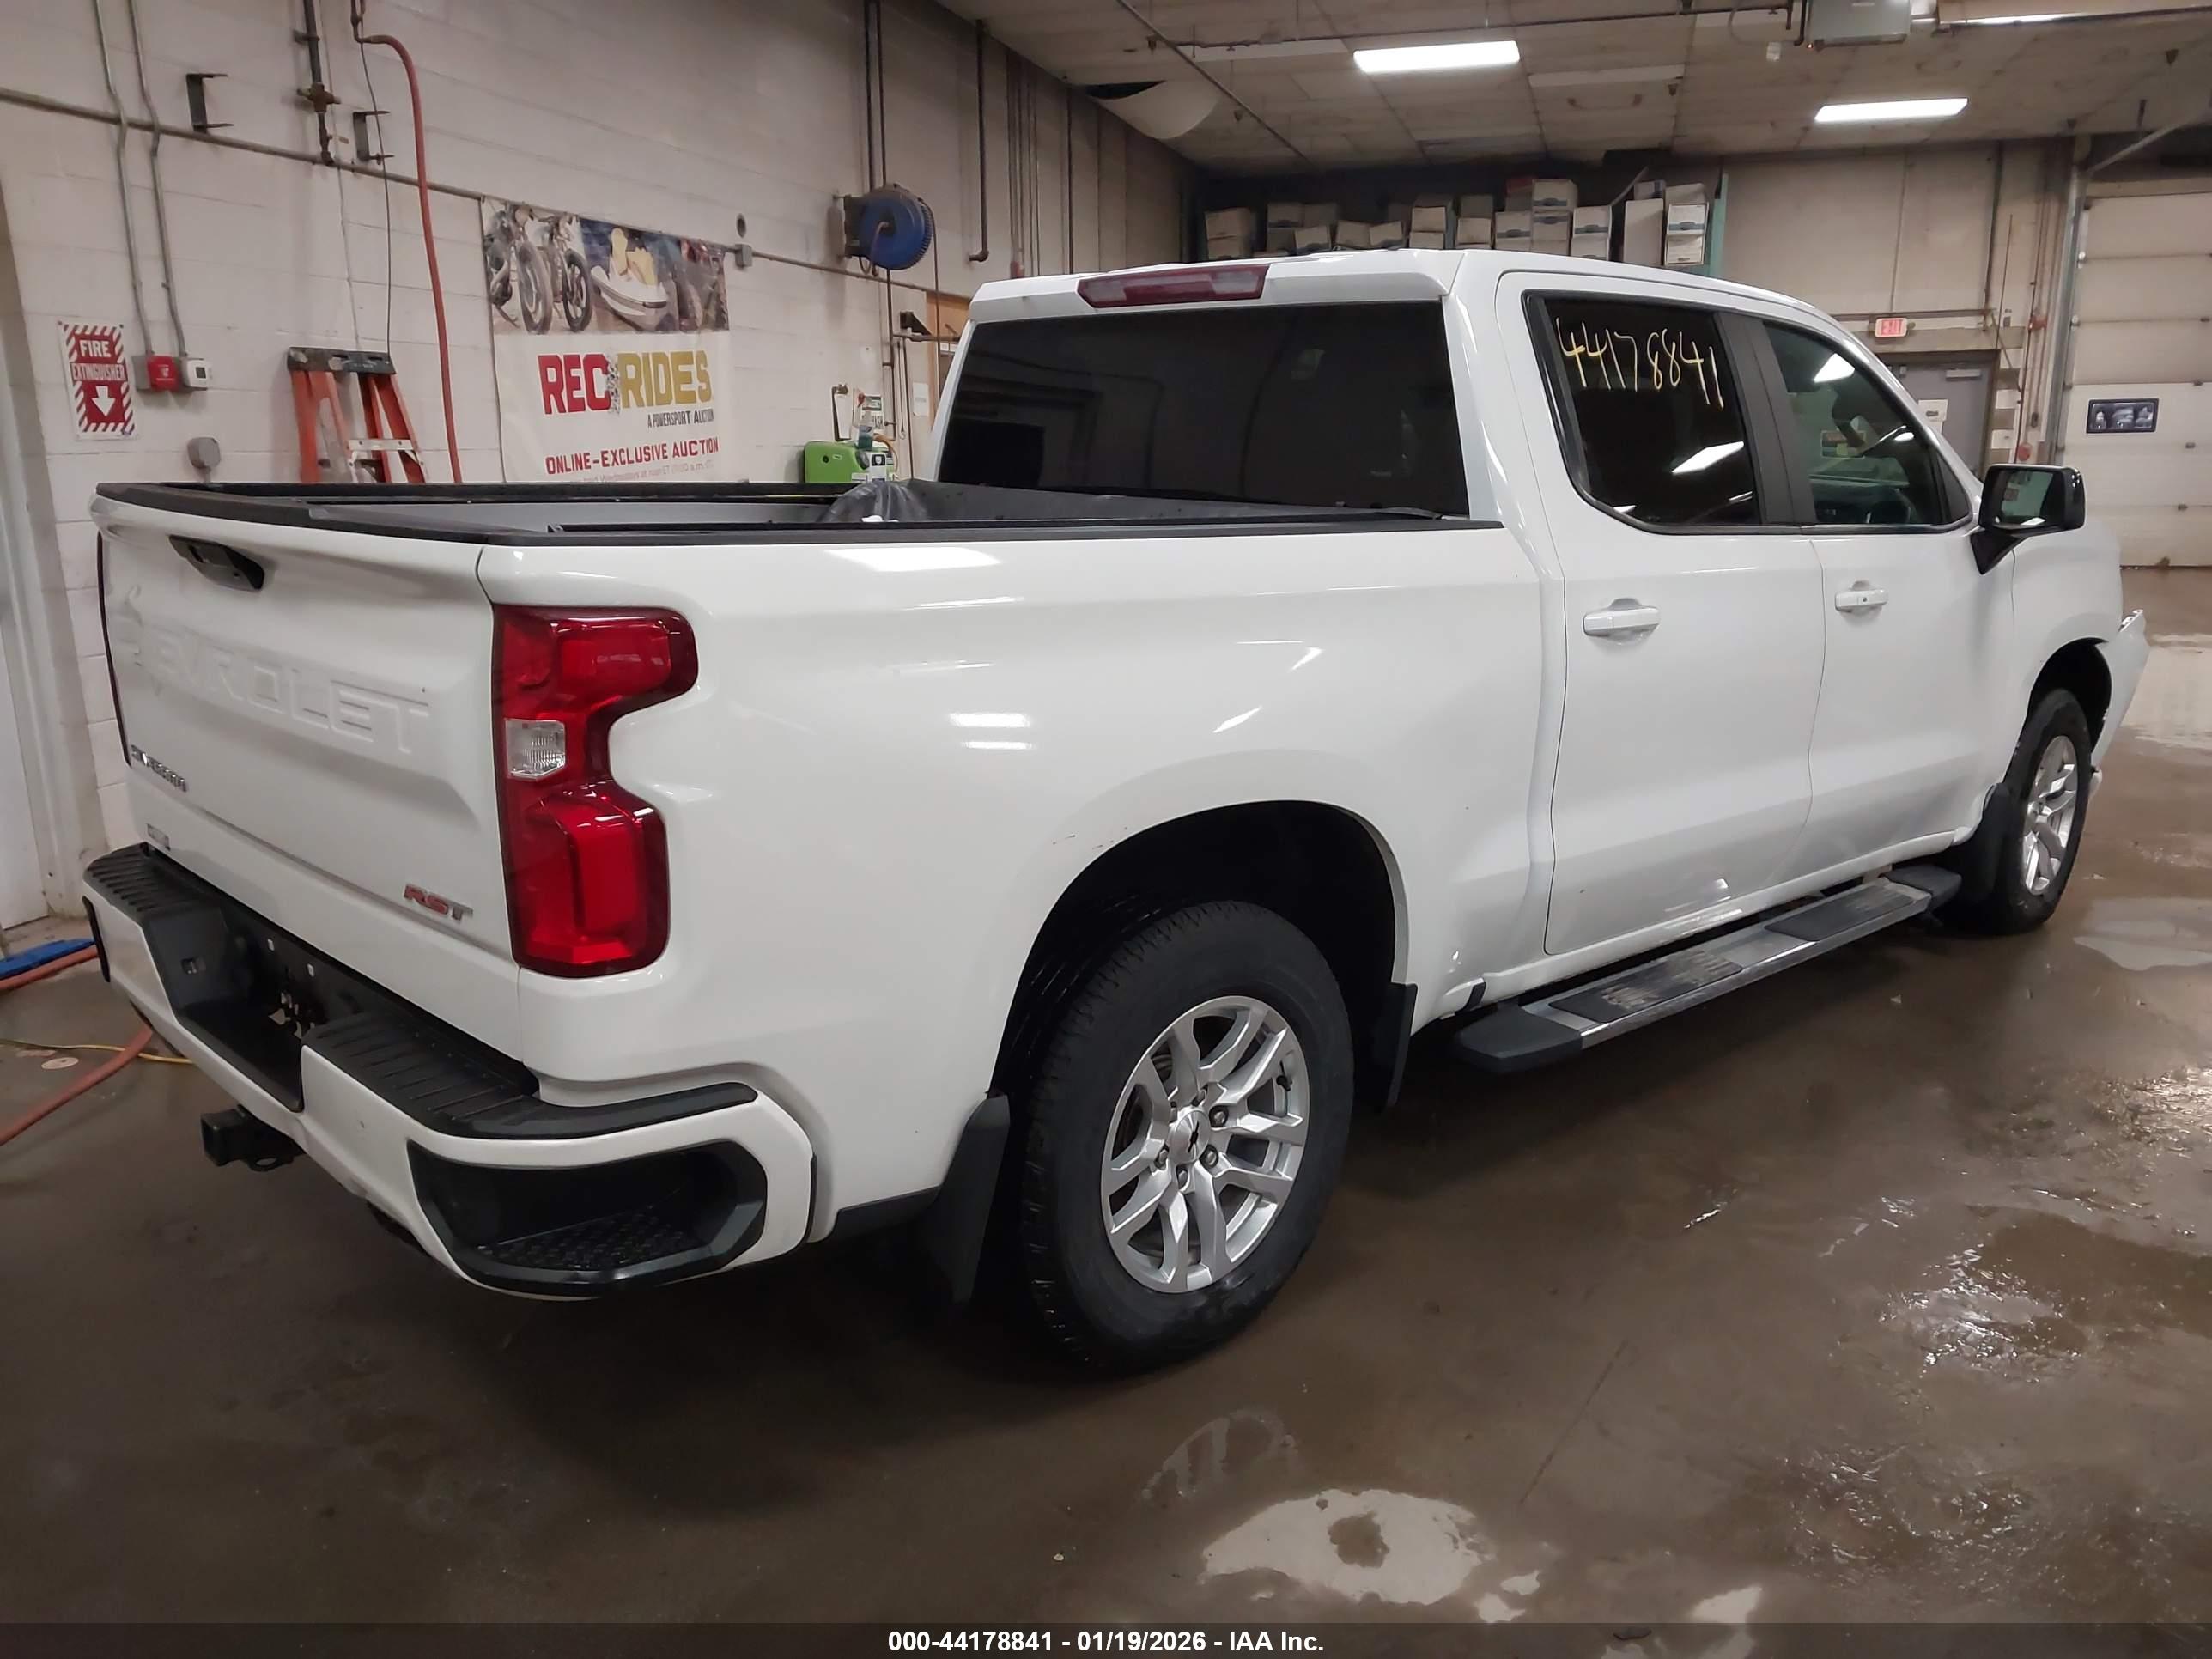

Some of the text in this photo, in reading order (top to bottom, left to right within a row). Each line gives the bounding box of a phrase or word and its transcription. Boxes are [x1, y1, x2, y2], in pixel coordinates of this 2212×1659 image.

[79, 340, 112, 357] FIRE
[72, 363, 126, 380] EXTINGUISHER
[1556, 318, 1723, 409] 44178841
[538, 350, 712, 414] REC RIDES
[653, 410, 691, 428] POWERSPORT
[672, 437, 719, 459] AUCTION
[404, 884, 473, 921] RST
